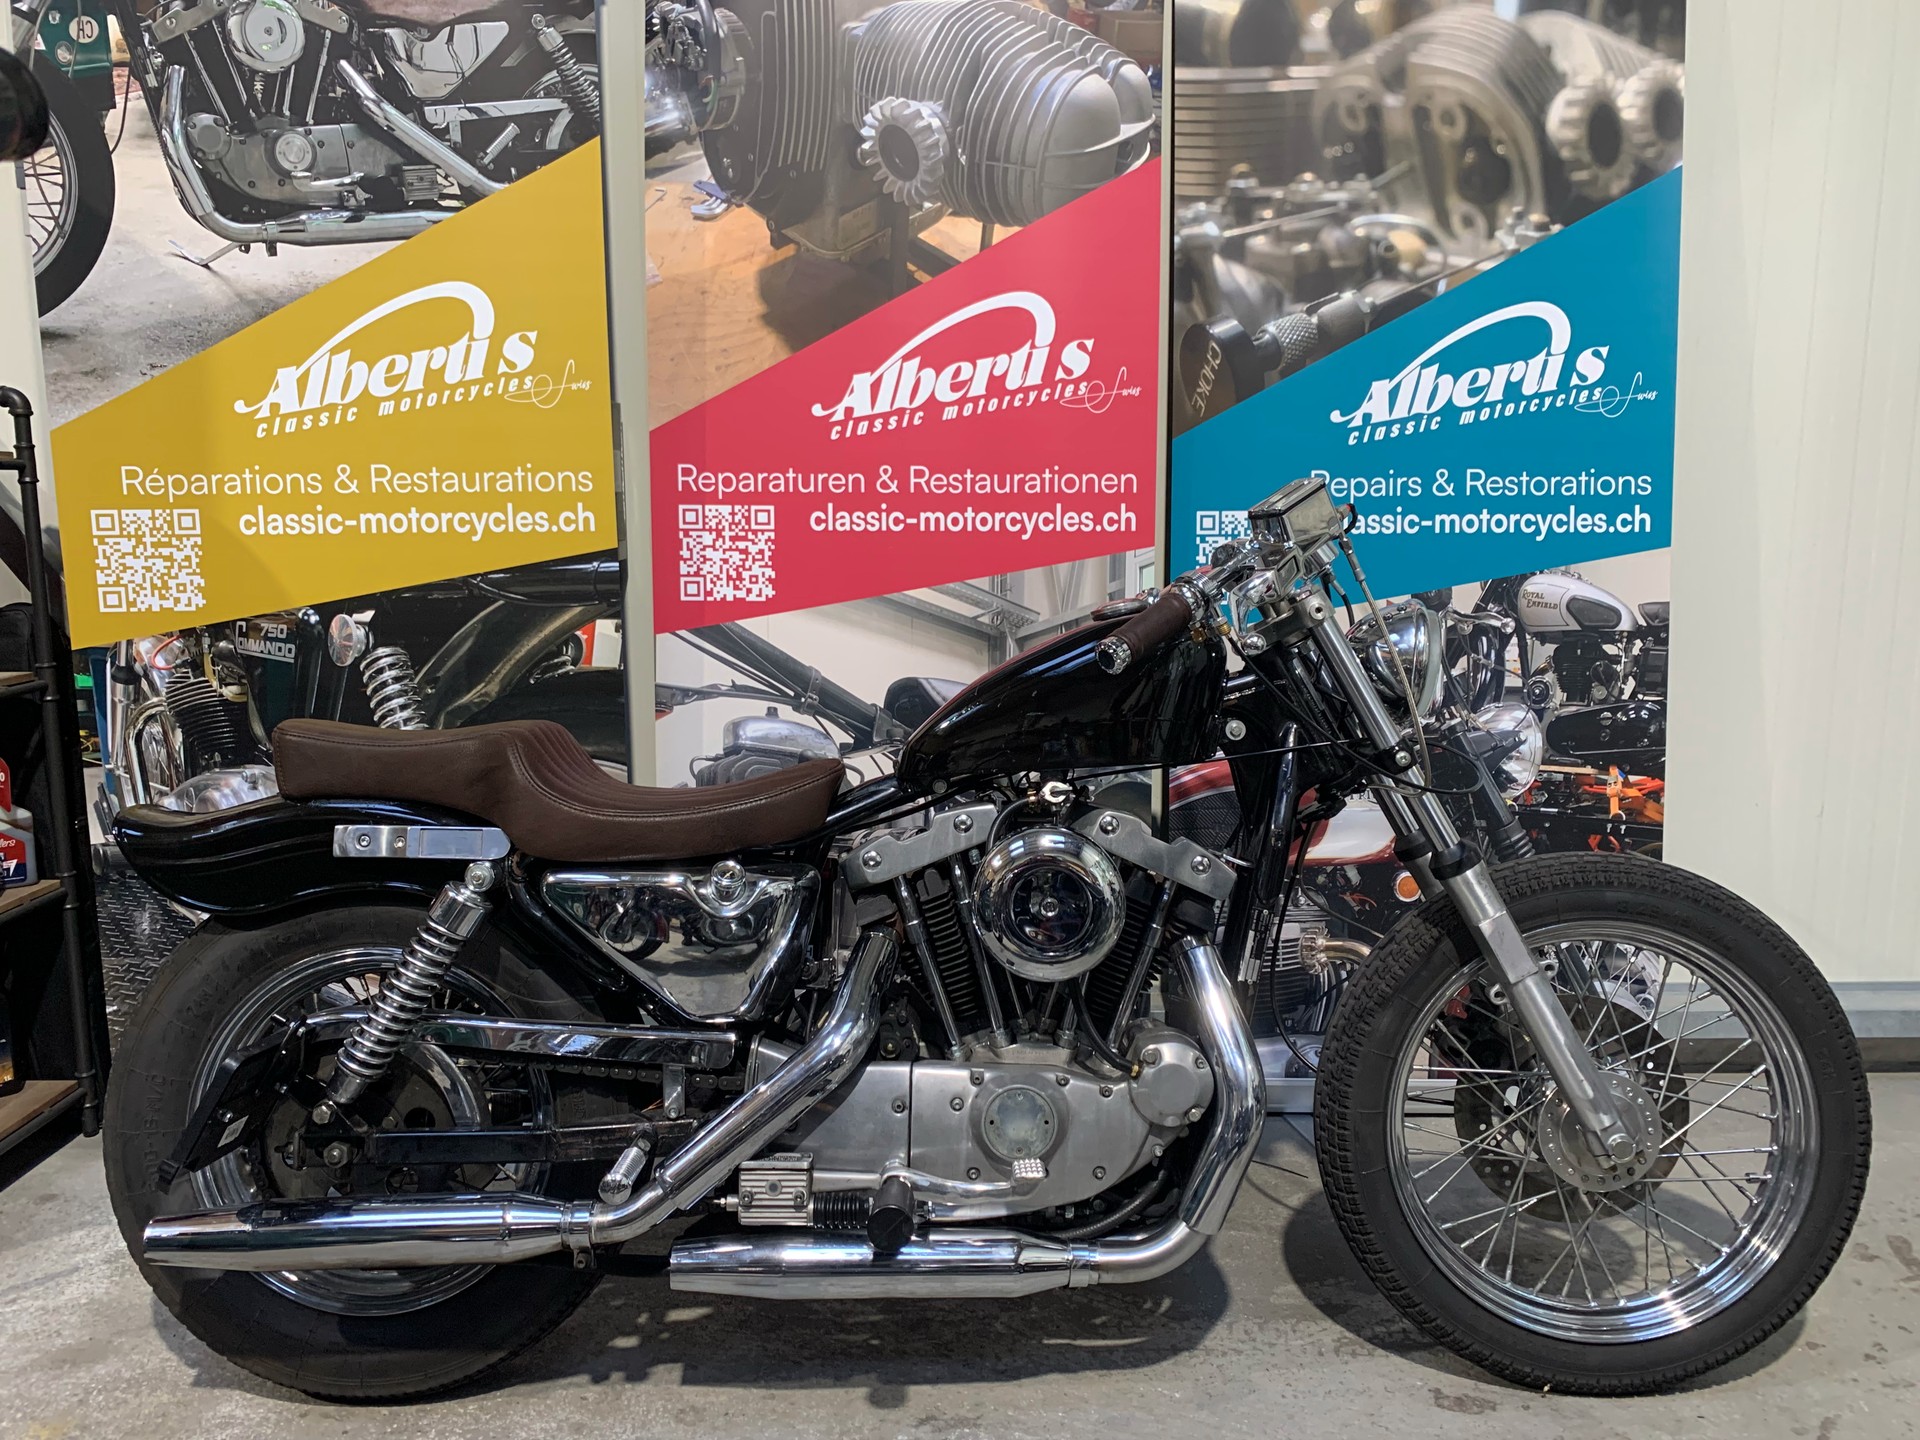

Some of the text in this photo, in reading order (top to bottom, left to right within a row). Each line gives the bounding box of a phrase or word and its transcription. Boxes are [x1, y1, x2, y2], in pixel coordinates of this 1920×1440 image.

[1191, 340, 1222, 417] CHOKE
[256, 405, 358, 438] classic
[378, 375, 534, 416] motorcycles
[830, 409, 925, 440] classic
[942, 381, 1088, 421] motorcycles
[1348, 414, 1442, 446] classic
[1459, 386, 1603, 425] motorcycles
[121, 463, 593, 503] Réparations & Restaurations
[677, 464, 1137, 500] Reparaturen & Restaurationen
[1432, 468, 1455, 497] &
[1466, 468, 1652, 496] Restorations
[239, 503, 596, 542] classic-motorcycles.ch
[809, 503, 1137, 540] classic-motorcycles.ch
[1343, 505, 1651, 542] assic-motorcycles.ch
[1522, 589, 1545, 600] ROYAL
[1526, 599, 1559, 610] ENFIELD
[236, 621, 296, 660] COMMANDO
[260, 623, 287, 639] 750
